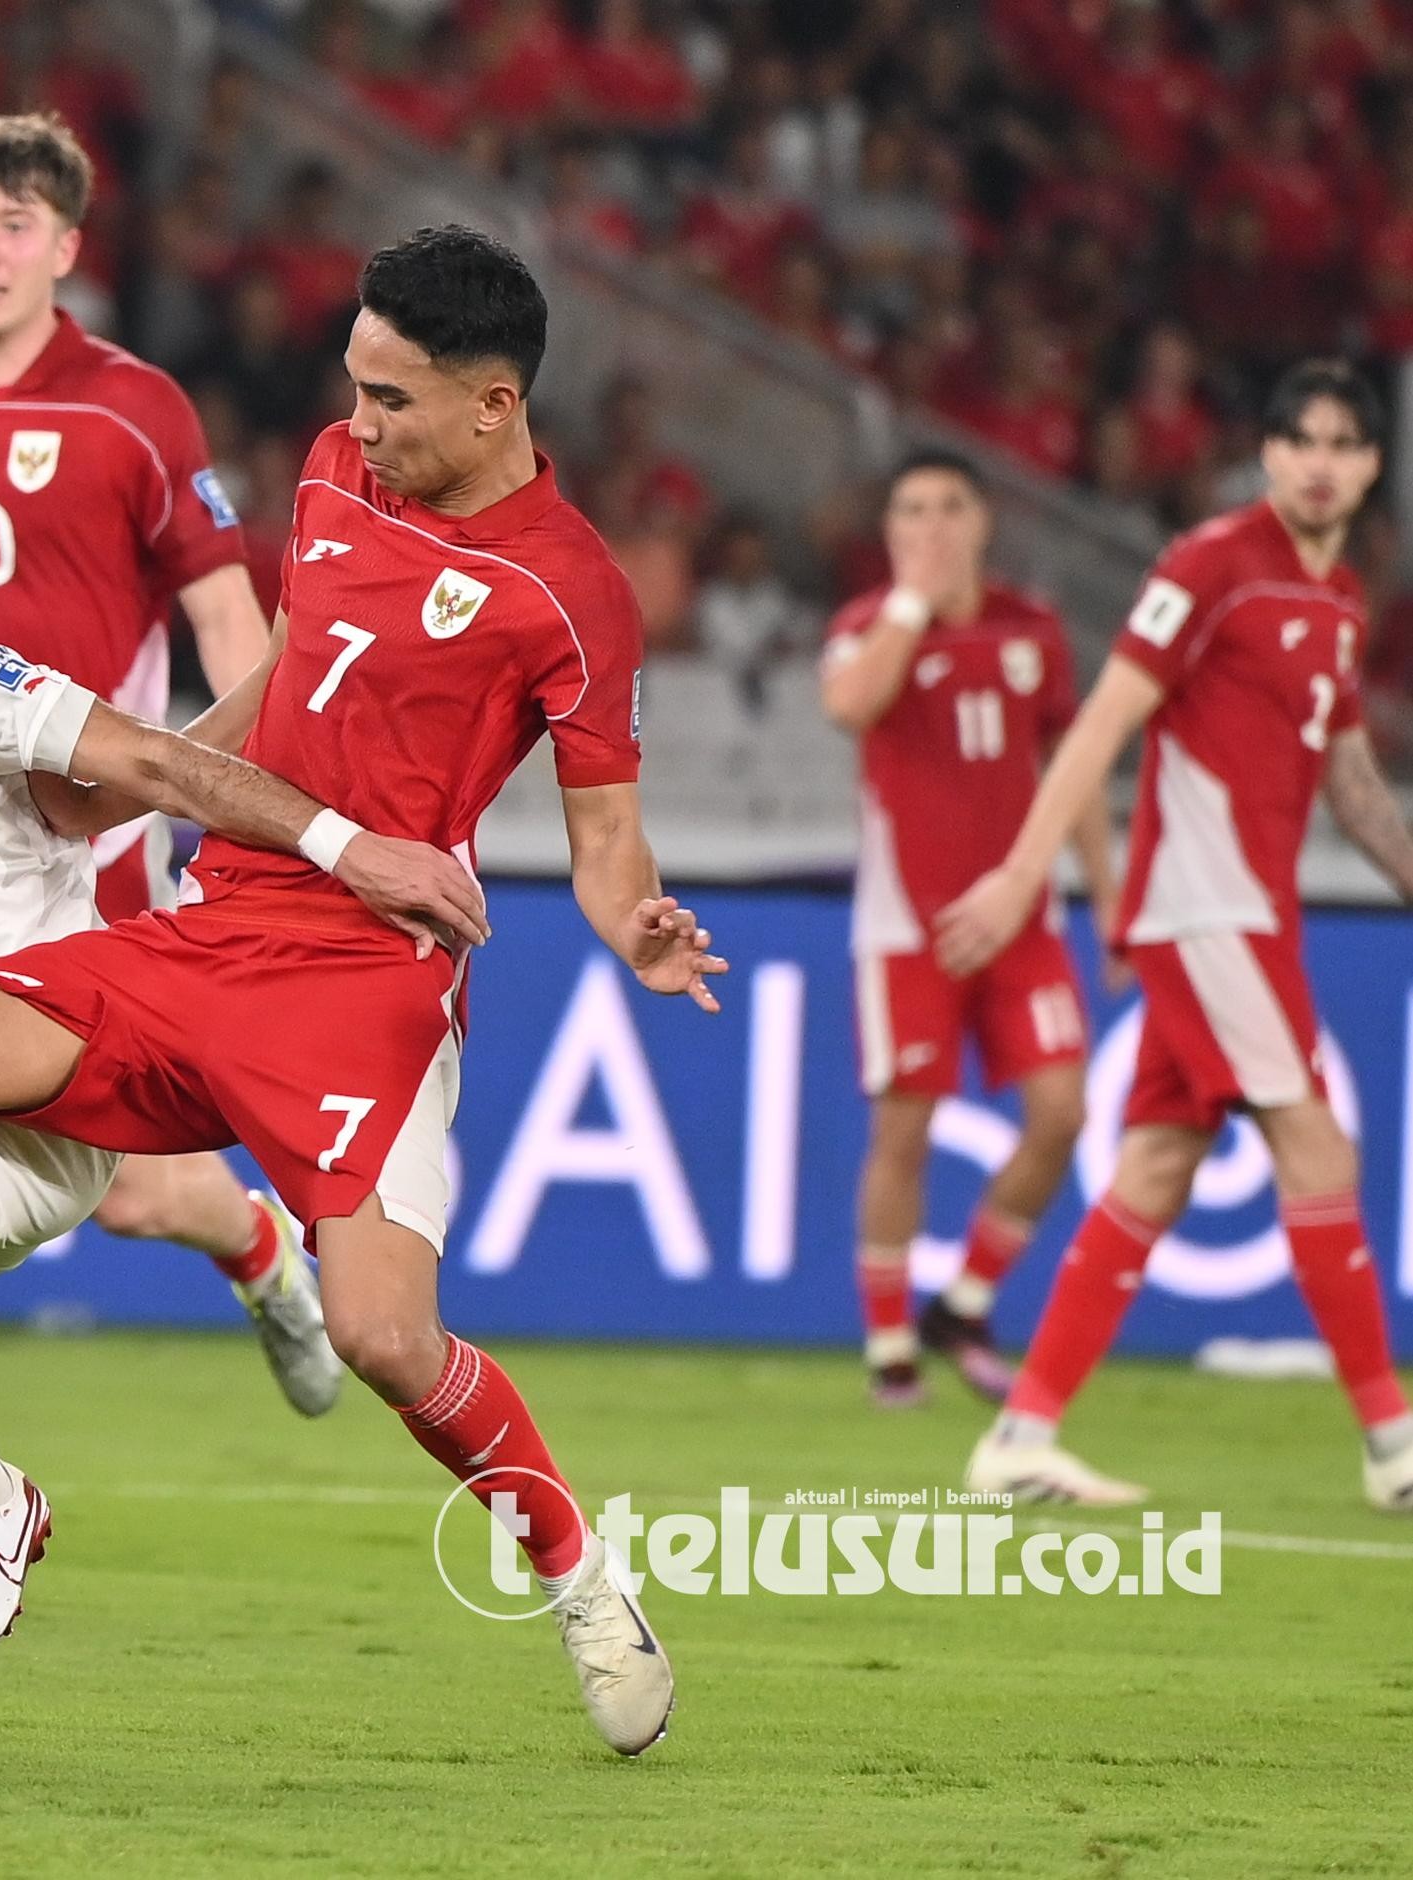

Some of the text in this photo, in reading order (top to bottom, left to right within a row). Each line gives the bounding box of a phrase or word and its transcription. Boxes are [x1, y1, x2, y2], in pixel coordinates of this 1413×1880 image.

[306, 619, 377, 714] 7
[954, 689, 1004, 761] 11
[318, 1094, 377, 1172] 7
